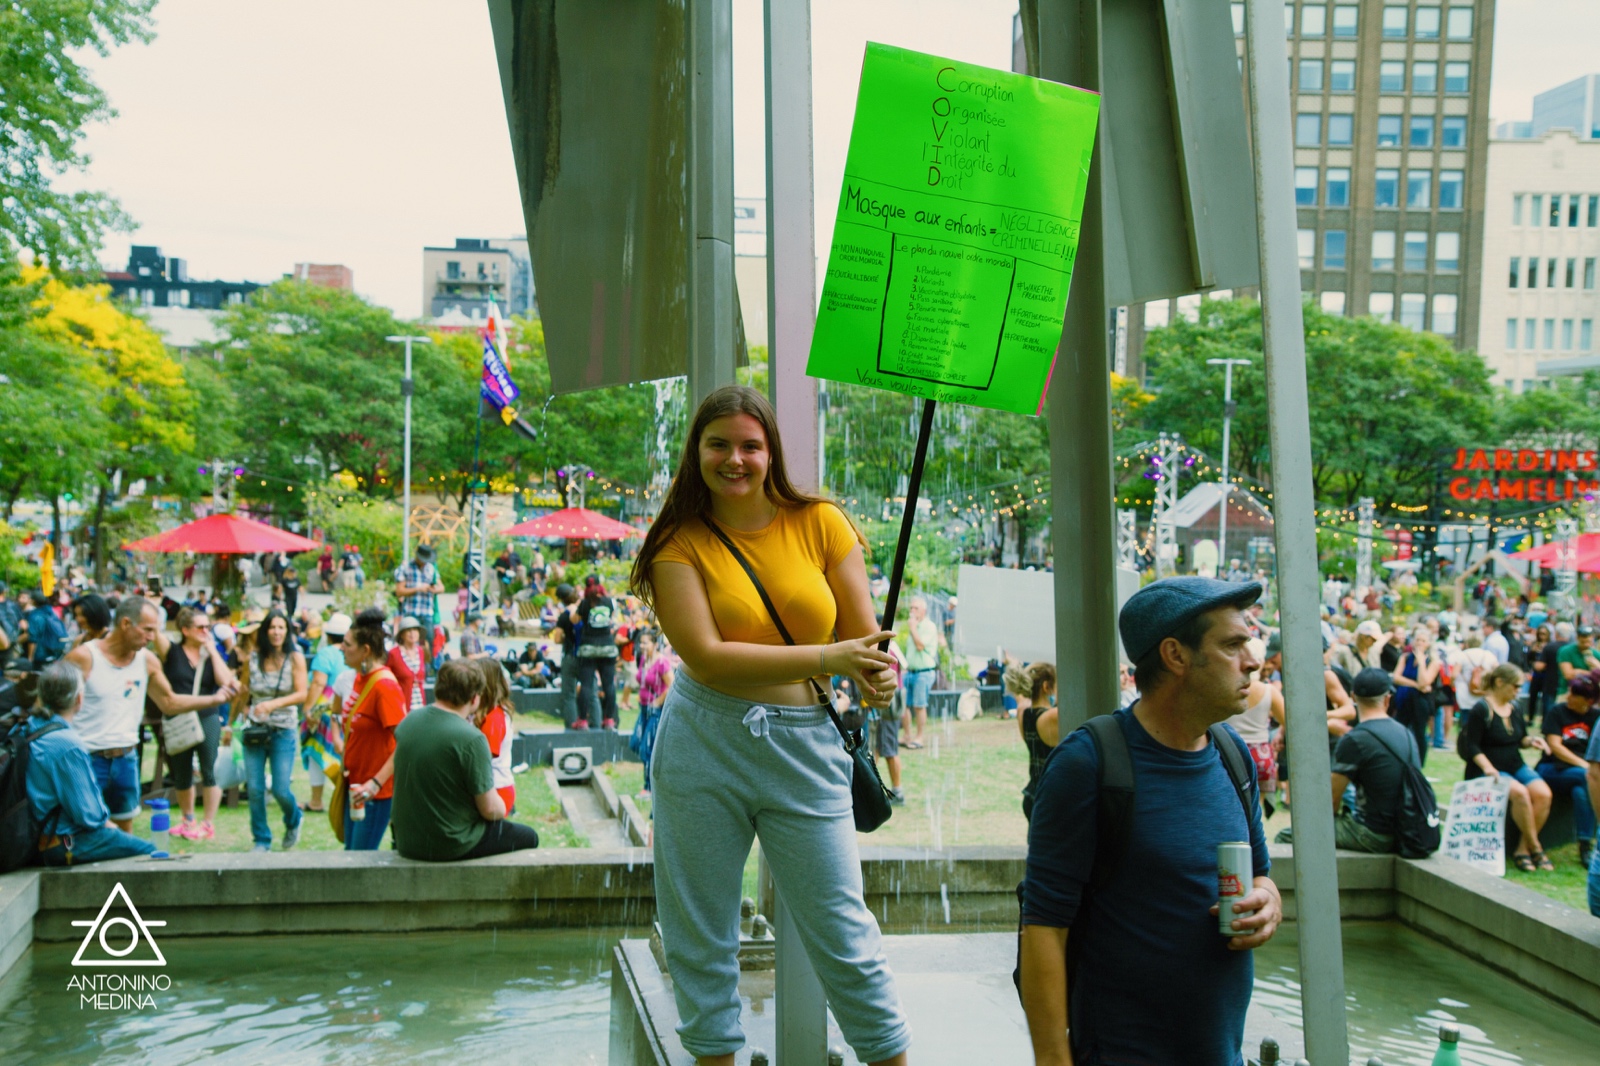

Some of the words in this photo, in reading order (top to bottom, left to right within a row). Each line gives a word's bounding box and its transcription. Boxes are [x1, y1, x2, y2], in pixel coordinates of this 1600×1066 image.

[937, 67, 1014, 102] Corruption
[932, 97, 1006, 128] Organisée
[932, 117, 991, 153] Violant
[927, 166, 962, 191] Droit
[998, 155, 1016, 178] du
[846, 184, 906, 229] Masque
[914, 211, 941, 227] aux
[944, 213, 987, 237] enfants
[1000, 212, 1077, 240] NÉGLIGENCE
[895, 235, 908, 253] Le
[911, 243, 927, 258] plan
[927, 244, 937, 256] du
[939, 249, 964, 260] nouvel
[966, 252, 983, 263] ordre
[985, 258, 1014, 269] mondial
[855, 367, 884, 387] Vous
[890, 378, 926, 396] voulez
[1452, 447, 1599, 472] JARDINS
